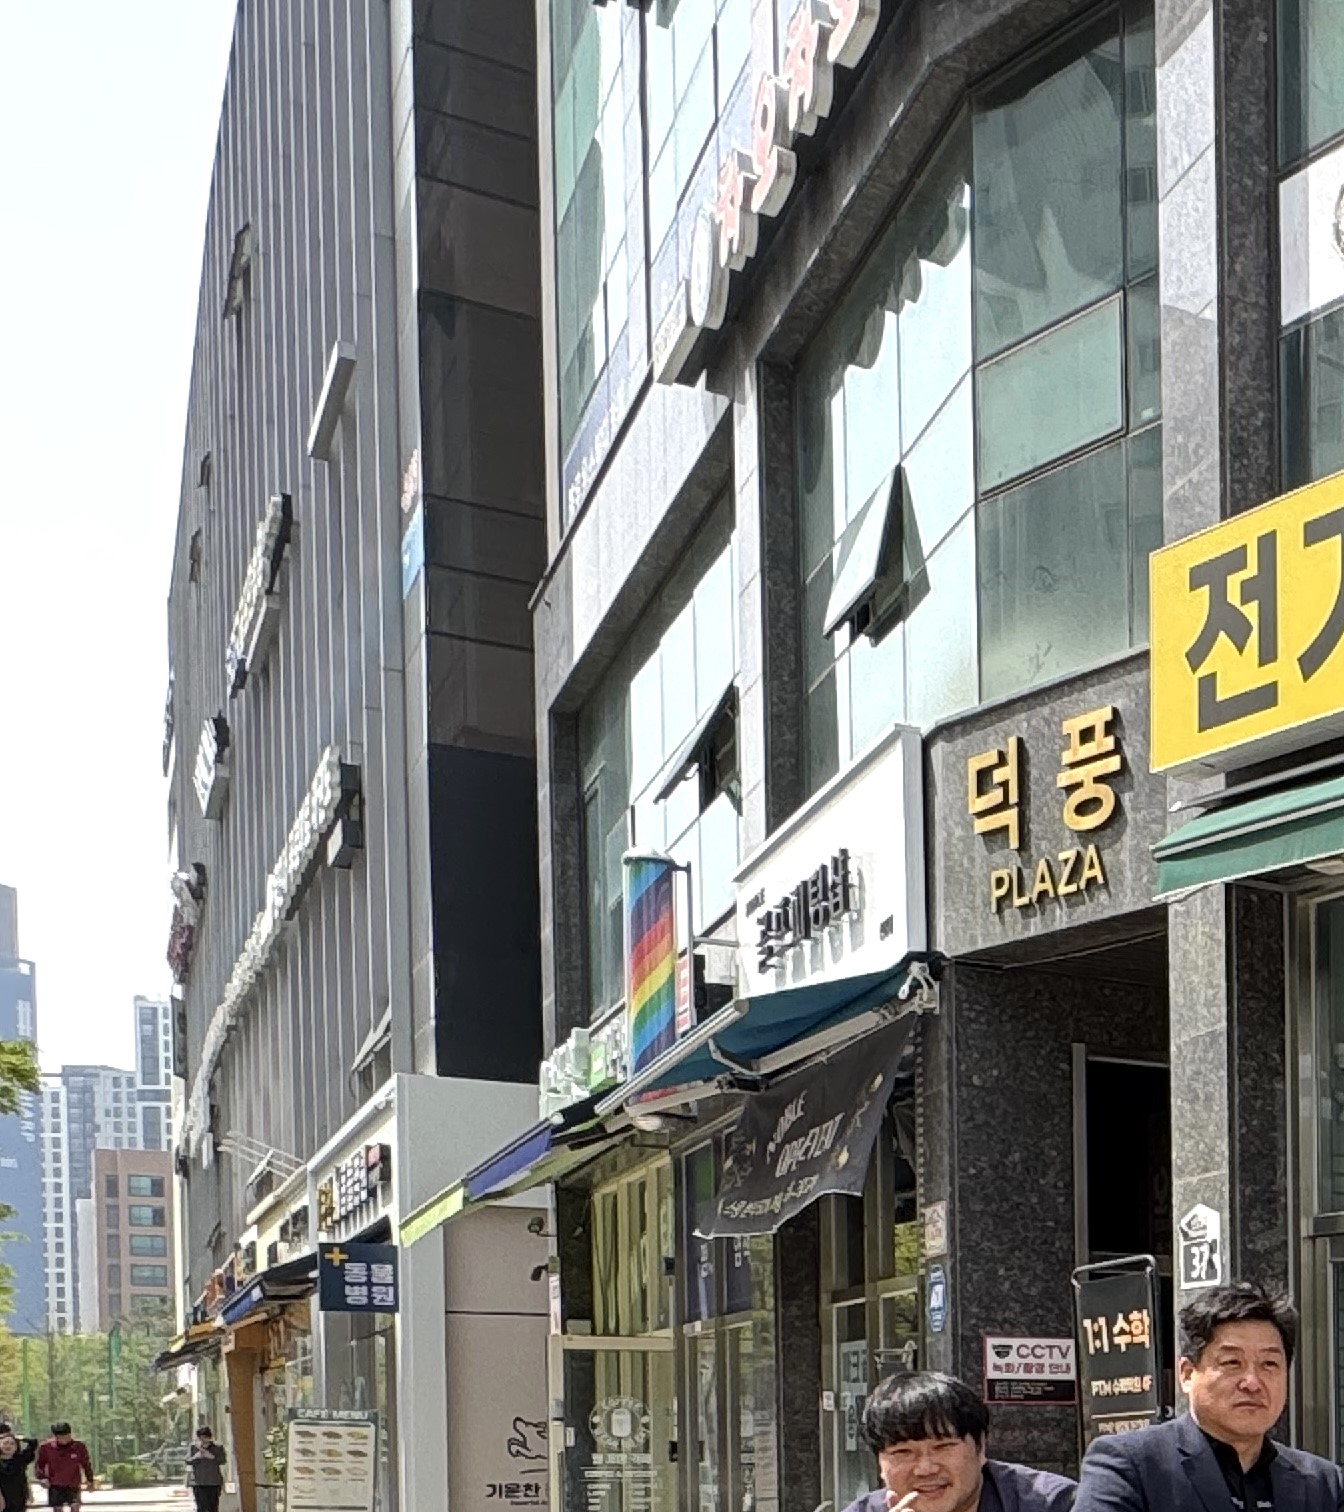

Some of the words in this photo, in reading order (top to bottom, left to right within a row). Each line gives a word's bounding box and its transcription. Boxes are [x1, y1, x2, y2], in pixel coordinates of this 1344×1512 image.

[966, 705, 1123, 851] 덕풍
[990, 845, 1104, 914] PLAZA
[345, 1284, 395, 1305] 병원
[1016, 1344, 1071, 1360] CCTV
[1113, 1309, 1150, 1353] 수학
